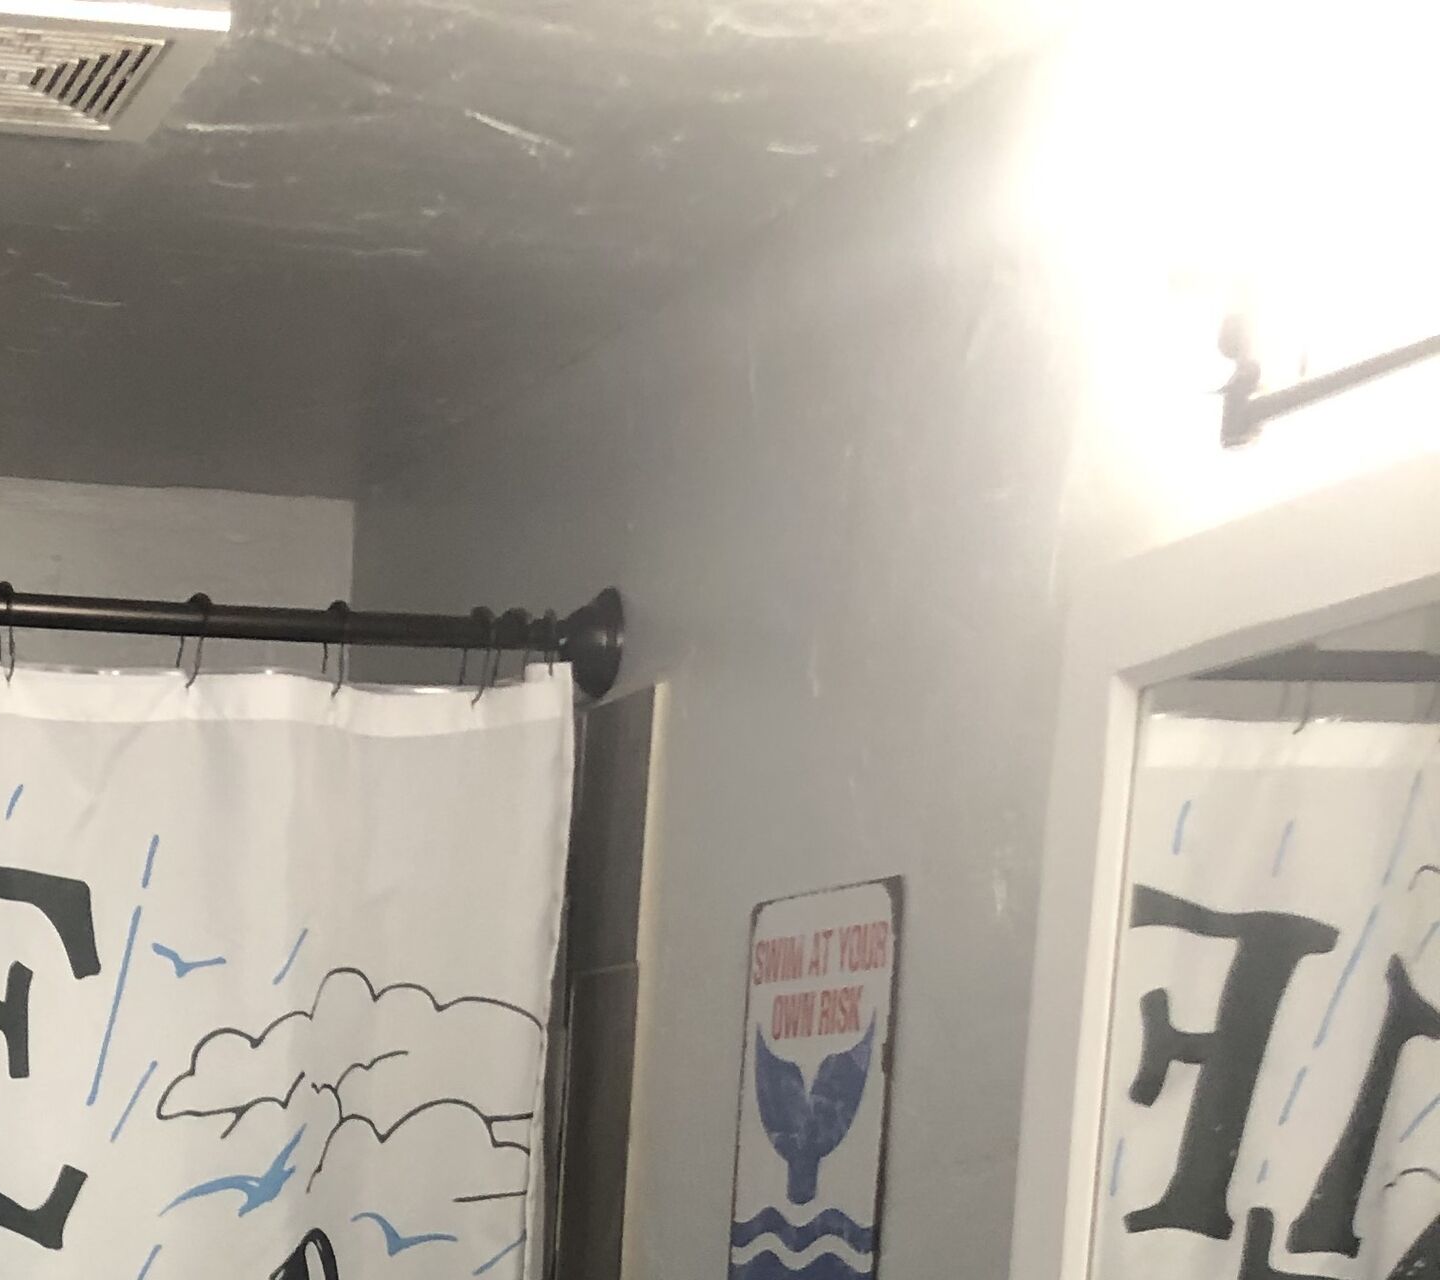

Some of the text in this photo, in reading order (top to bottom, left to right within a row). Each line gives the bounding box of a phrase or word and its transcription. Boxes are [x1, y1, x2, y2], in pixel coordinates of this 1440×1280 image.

[753, 920, 888, 985] SWIM AT YOUR
[772, 985, 864, 1041] OWN RISK
